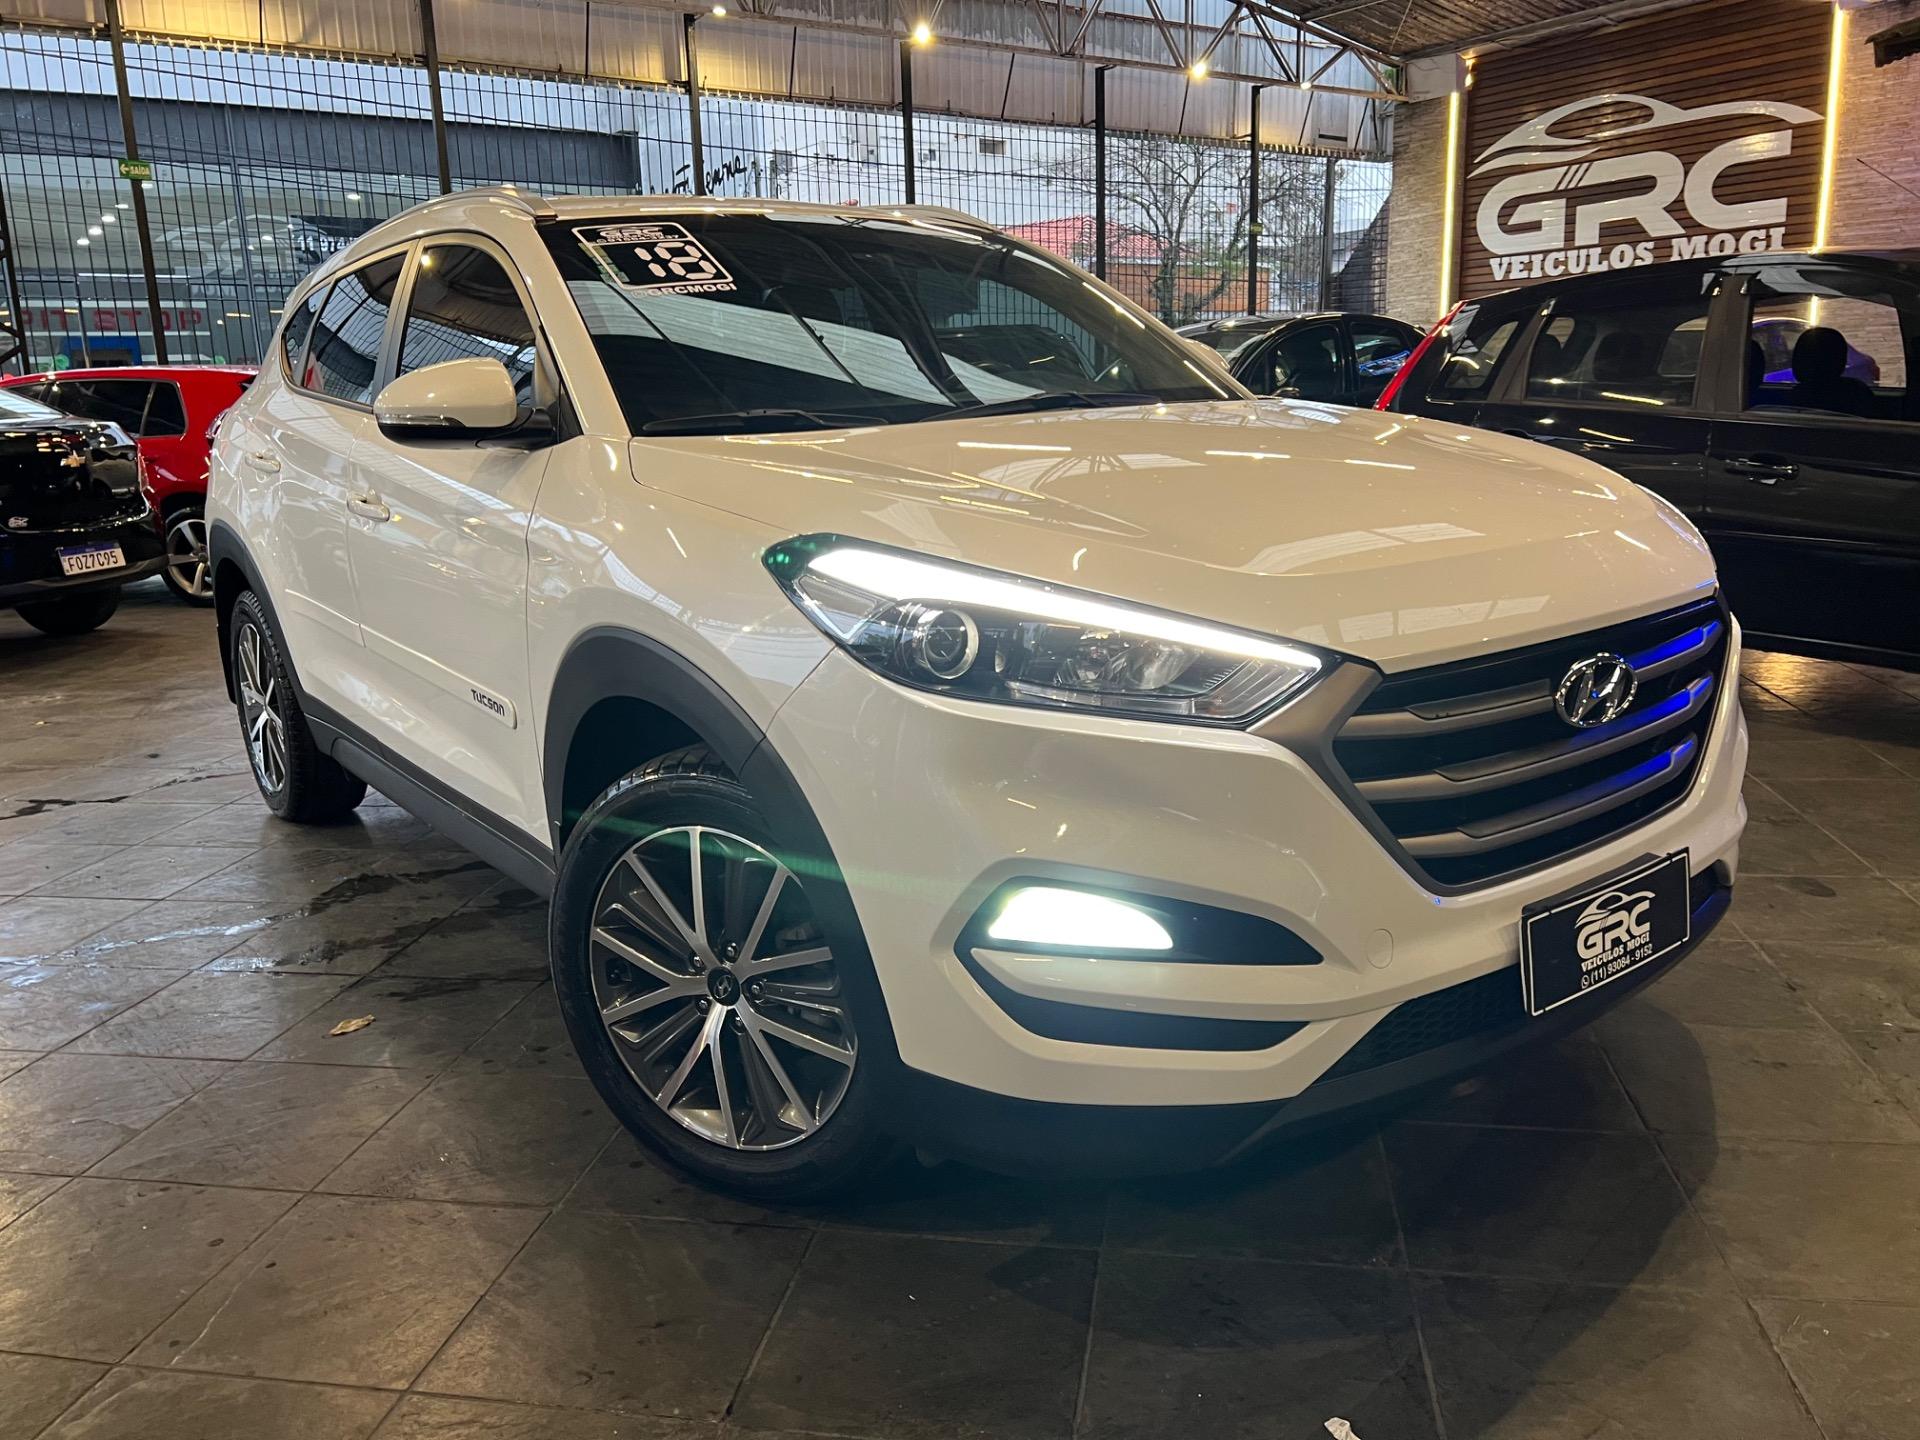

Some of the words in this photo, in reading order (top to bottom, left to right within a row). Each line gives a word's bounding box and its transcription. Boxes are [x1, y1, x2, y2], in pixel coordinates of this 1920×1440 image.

[1476, 128, 1793, 255] GRC
[634, 241, 717, 280] 18
[1489, 241, 1655, 280] VEICULOS
[1670, 227, 1786, 261] MOGI
[67, 550, 118, 572] FOZ7C95
[1577, 900, 1650, 960] GRC
[1581, 945, 1624, 972] VEICULOS
[1627, 932, 1650, 951] MOGI
[1590, 967, 1607, 985] (11)
